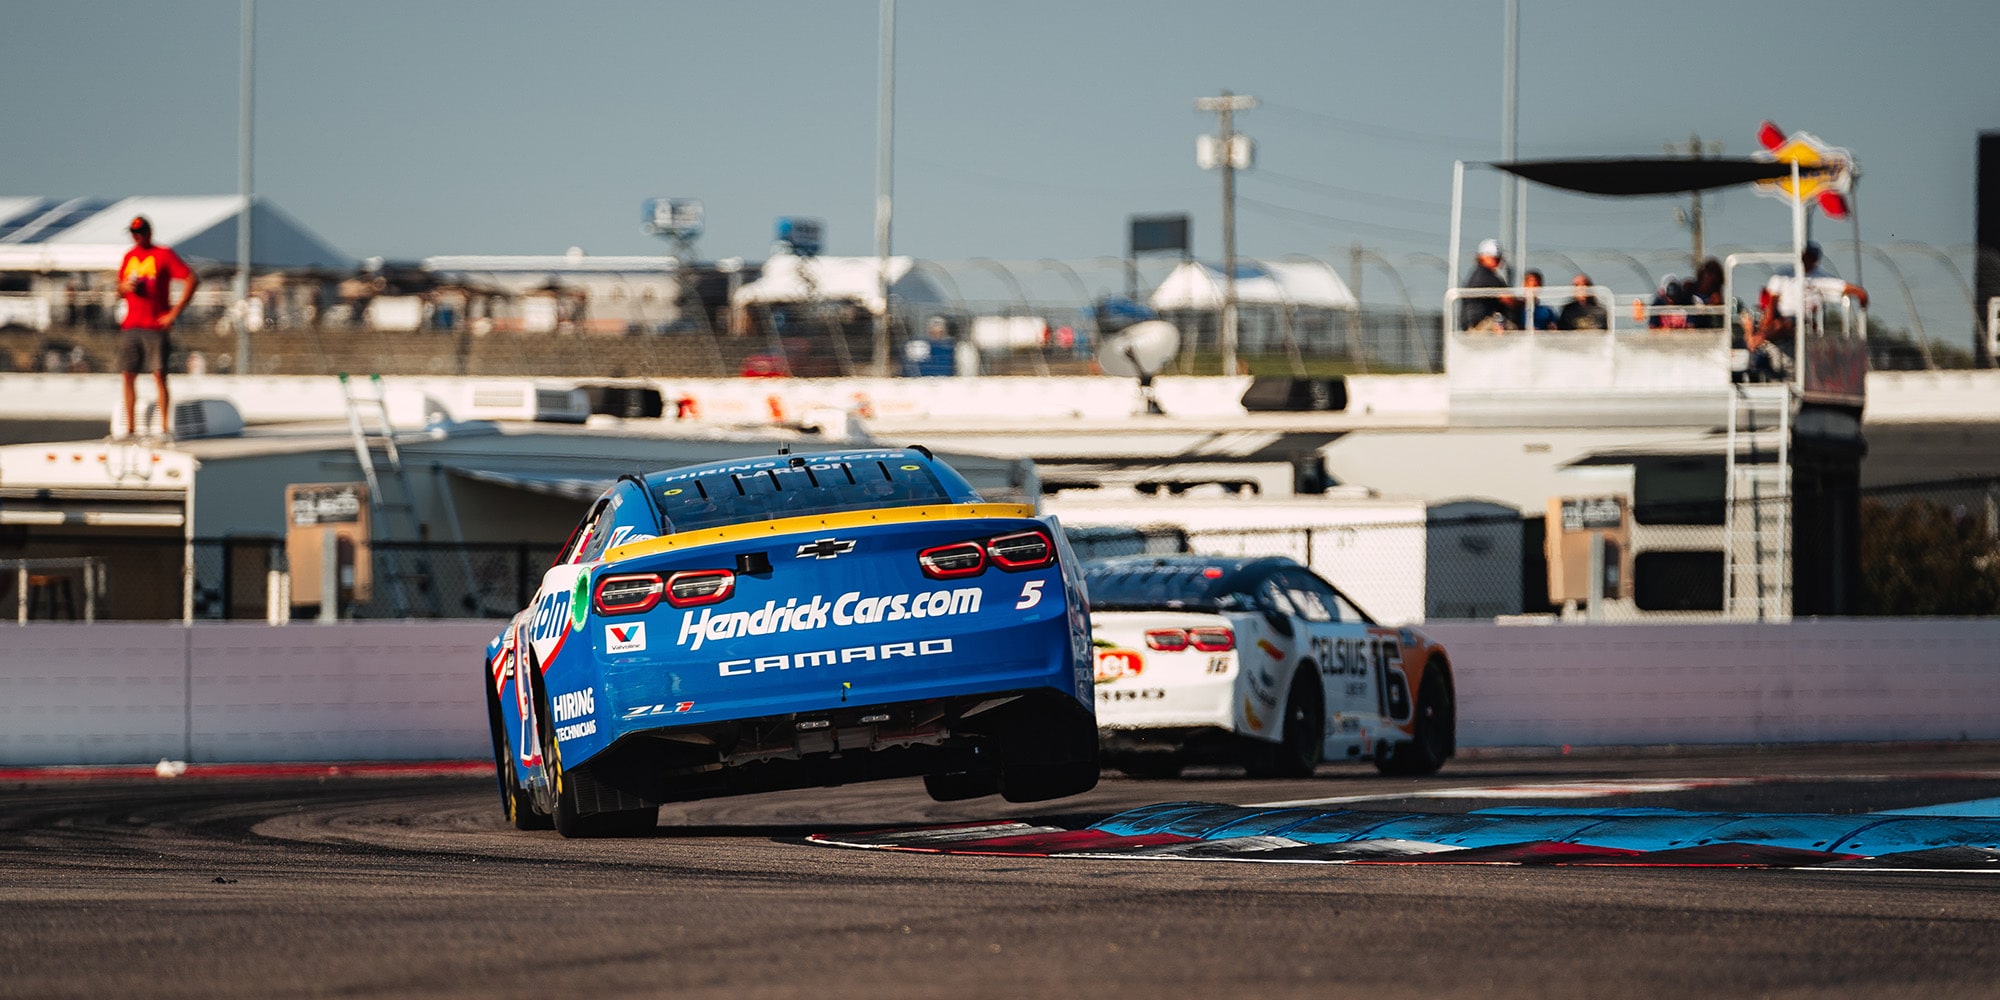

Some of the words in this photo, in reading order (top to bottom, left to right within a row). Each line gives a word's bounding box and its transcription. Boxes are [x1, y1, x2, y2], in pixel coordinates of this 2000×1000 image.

[665, 461, 777, 482] HIRING
[735, 462, 854, 480] LARSON
[1015, 580, 1047, 611] 5
[718, 638, 954, 677] CAMARO
[1206, 656, 1230, 674] 16
[1370, 636, 1413, 721] 16
[553, 686, 595, 723] HIRING
[555, 719, 597, 742] TECHNICIANS
